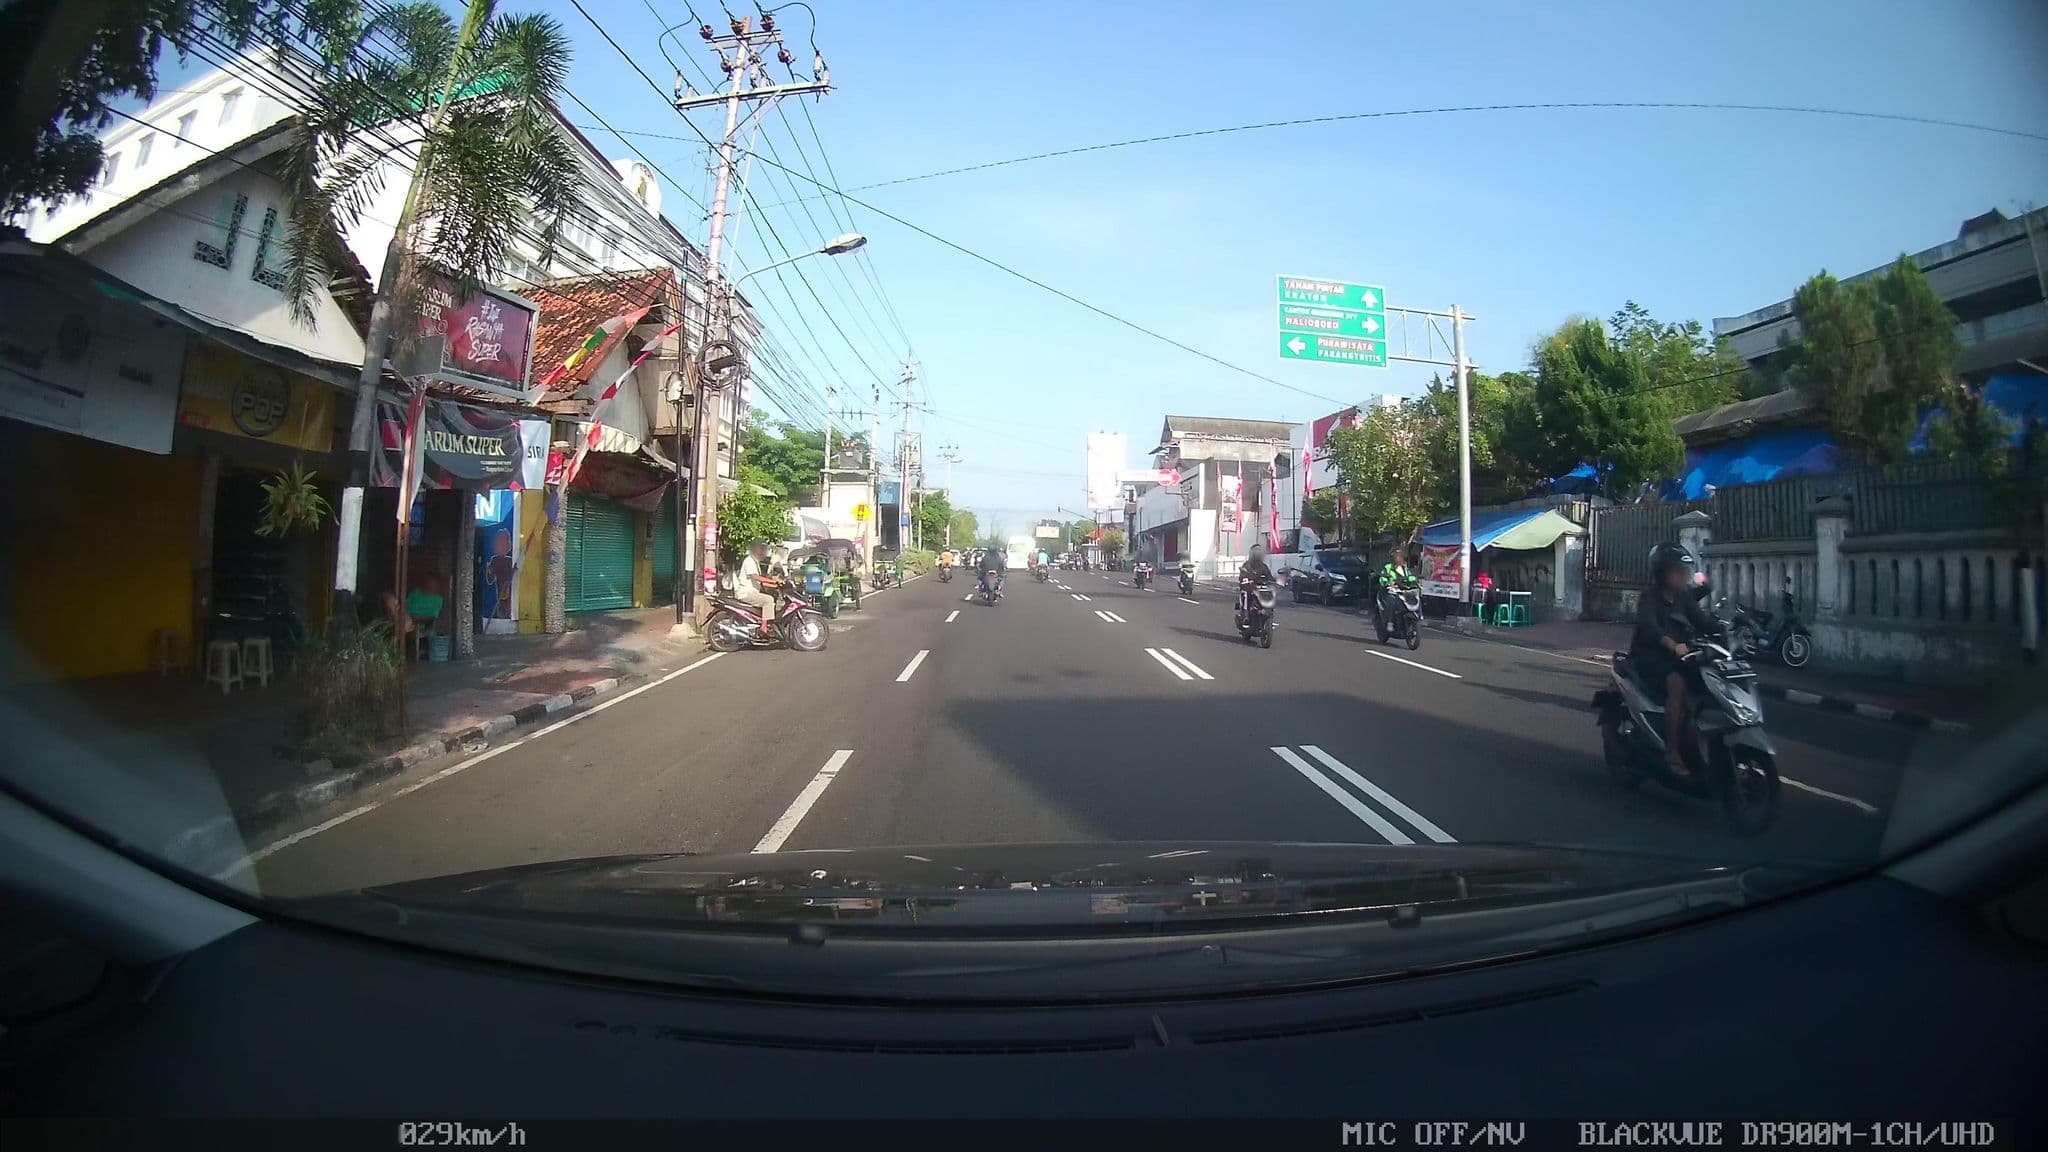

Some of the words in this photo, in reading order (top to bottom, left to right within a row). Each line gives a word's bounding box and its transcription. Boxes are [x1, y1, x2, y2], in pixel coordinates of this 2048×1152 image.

[1285, 291, 1327, 301] KRATON
[1285, 316, 1339, 329] MALIOBORO
[467, 339, 501, 362] SUPER
[1318, 338, 1373, 351] PURAWISATA
[1318, 350, 1381, 363] PARANGTRITIS
[241, 391, 285, 425] POP
[424, 431, 465, 454] ARUM
[465, 435, 505, 457] SUPER
